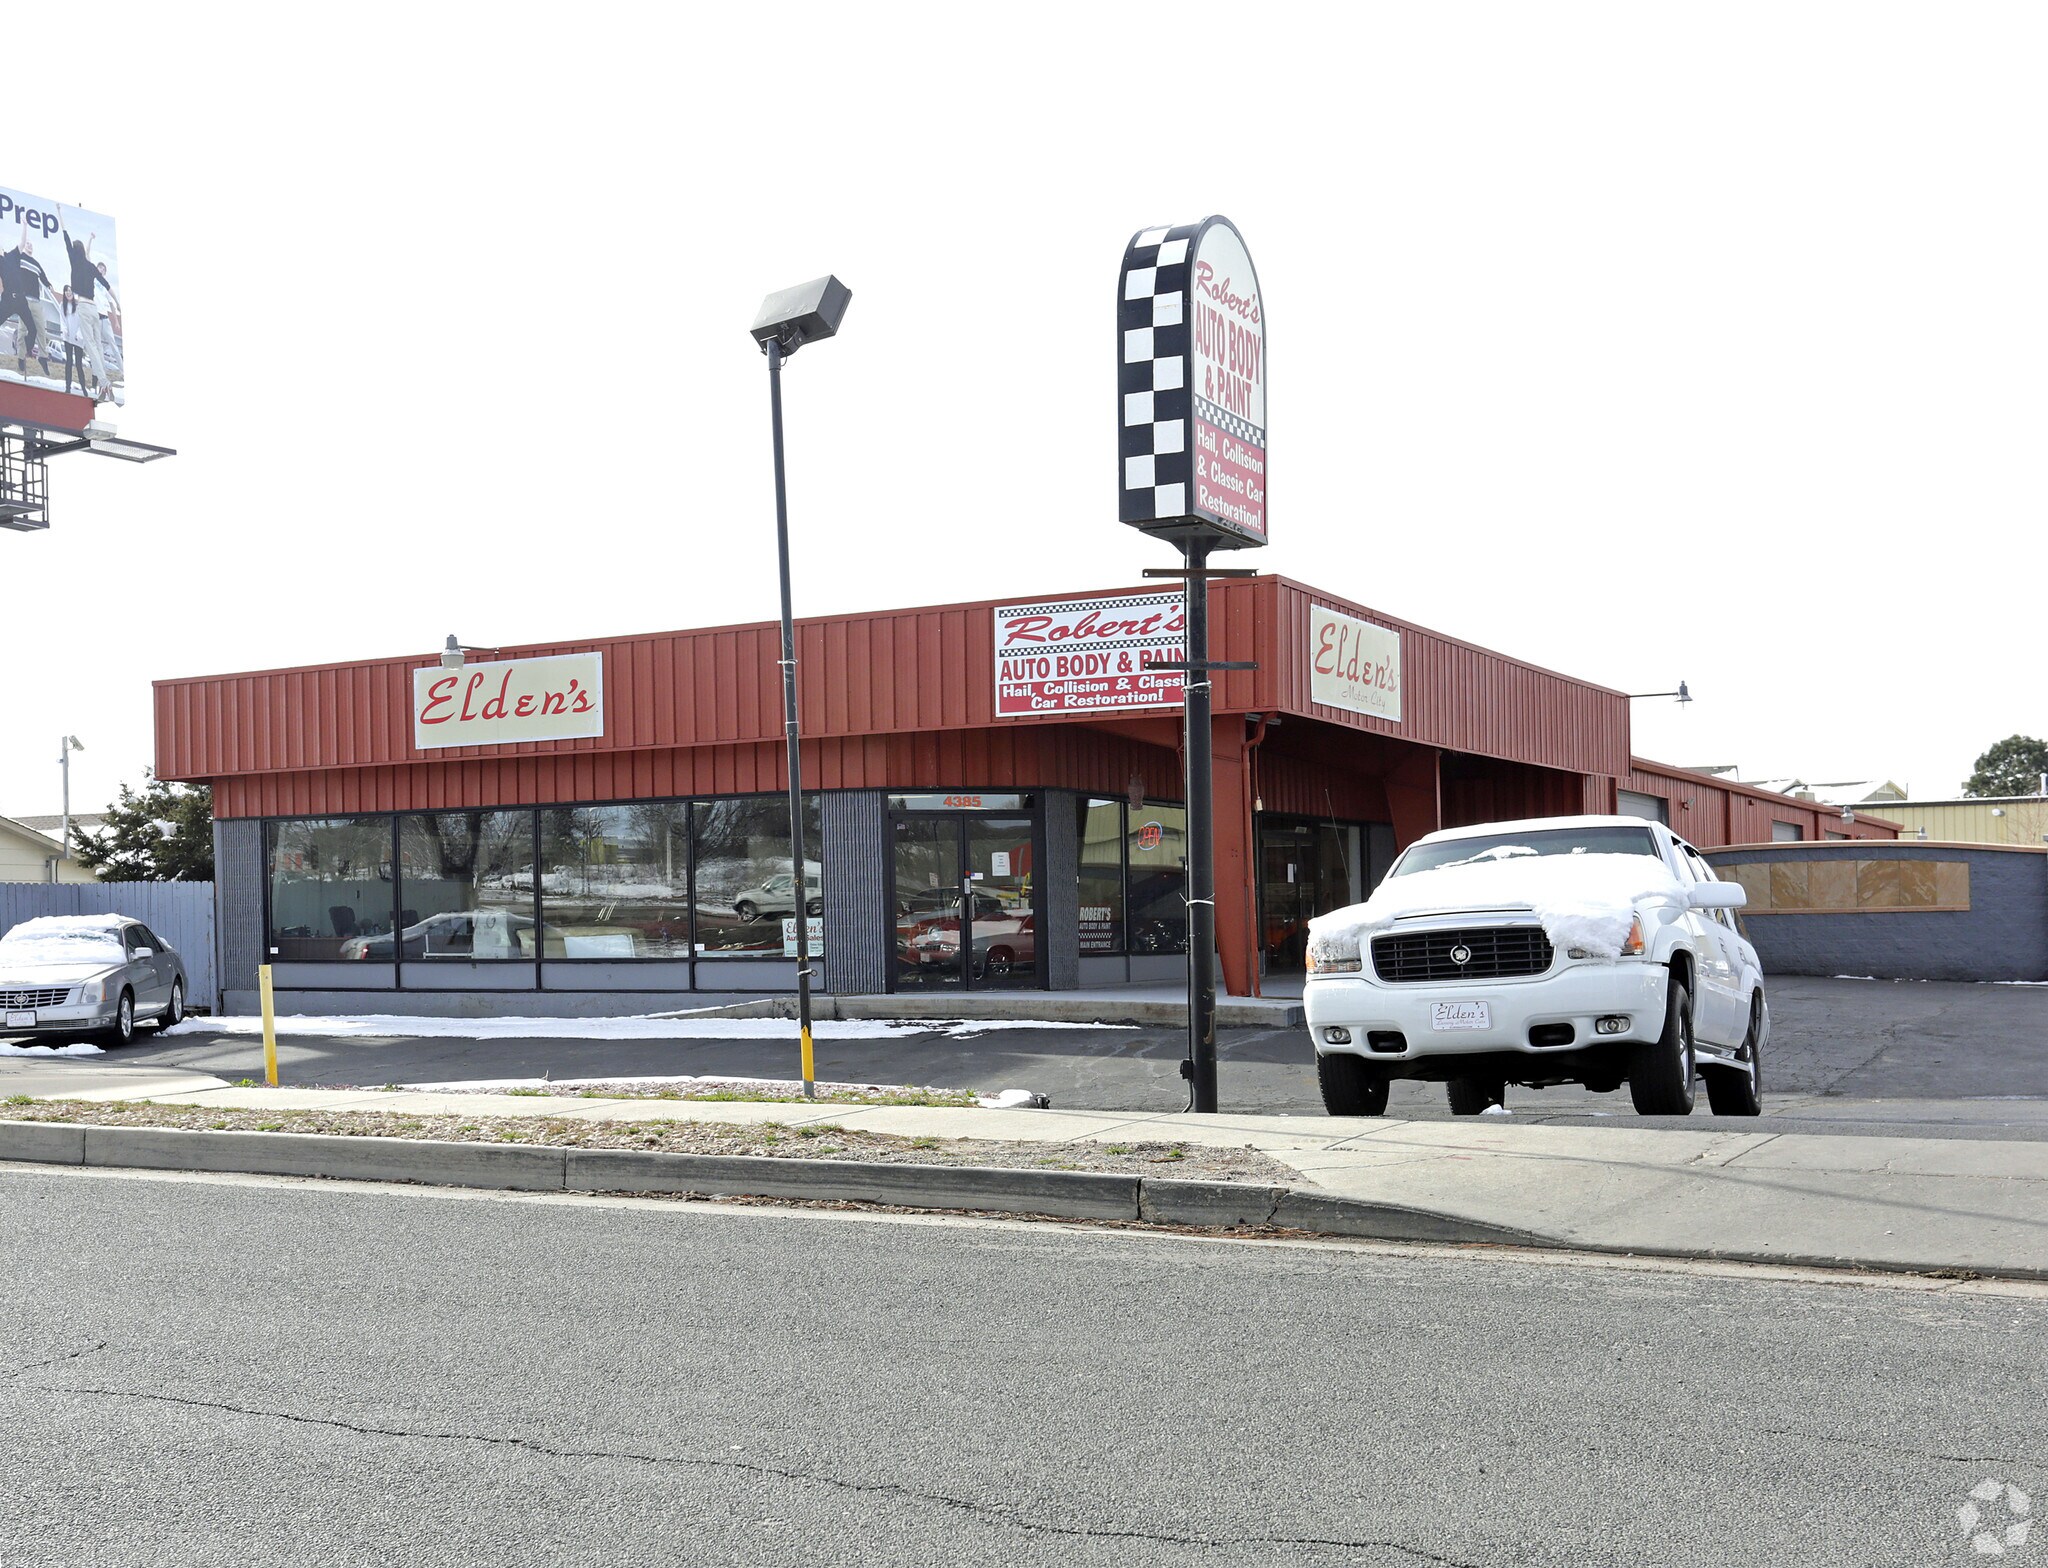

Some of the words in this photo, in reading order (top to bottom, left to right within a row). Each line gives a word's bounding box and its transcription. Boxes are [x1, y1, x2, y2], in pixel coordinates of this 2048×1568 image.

[0, 193, 59, 239] Prep
[1196, 260, 1260, 324] Robert's
[1196, 300, 1226, 366] AUTO
[1229, 320, 1261, 385] BODY
[1205, 364, 1214, 401] &
[1217, 366, 1252, 420] PAINT
[1197, 423, 1219, 458] Hail,
[1222, 437, 1263, 475] Collision
[1197, 455, 1207, 479] &
[1210, 461, 1244, 495] Classic
[1246, 478, 1264, 504] Car
[1199, 484, 1262, 530] Restoration!
[1003, 604, 1185, 646] Robert's
[1000, 657, 1051, 682] AUTO
[1056, 652, 1112, 678] BODY
[1116, 650, 1133, 674] &
[1139, 647, 1185, 672] PAIN
[1315, 622, 1397, 692] Elden's
[420, 668, 596, 725] Elden's
[1002, 683, 1036, 698] Hail,
[1043, 680, 1109, 695] Collision
[1115, 677, 1132, 691] &
[1138, 674, 1185, 689] Classi
[1031, 696, 1058, 709] Car
[1064, 688, 1164, 708] Restoration!
[943, 796, 982, 808] 4385
[1138, 826, 1160, 846] OPEN
[786, 921, 823, 934] Elen's
[1080, 906, 1112, 922] ROBERT'S
[1435, 1004, 1485, 1019] Elden's
